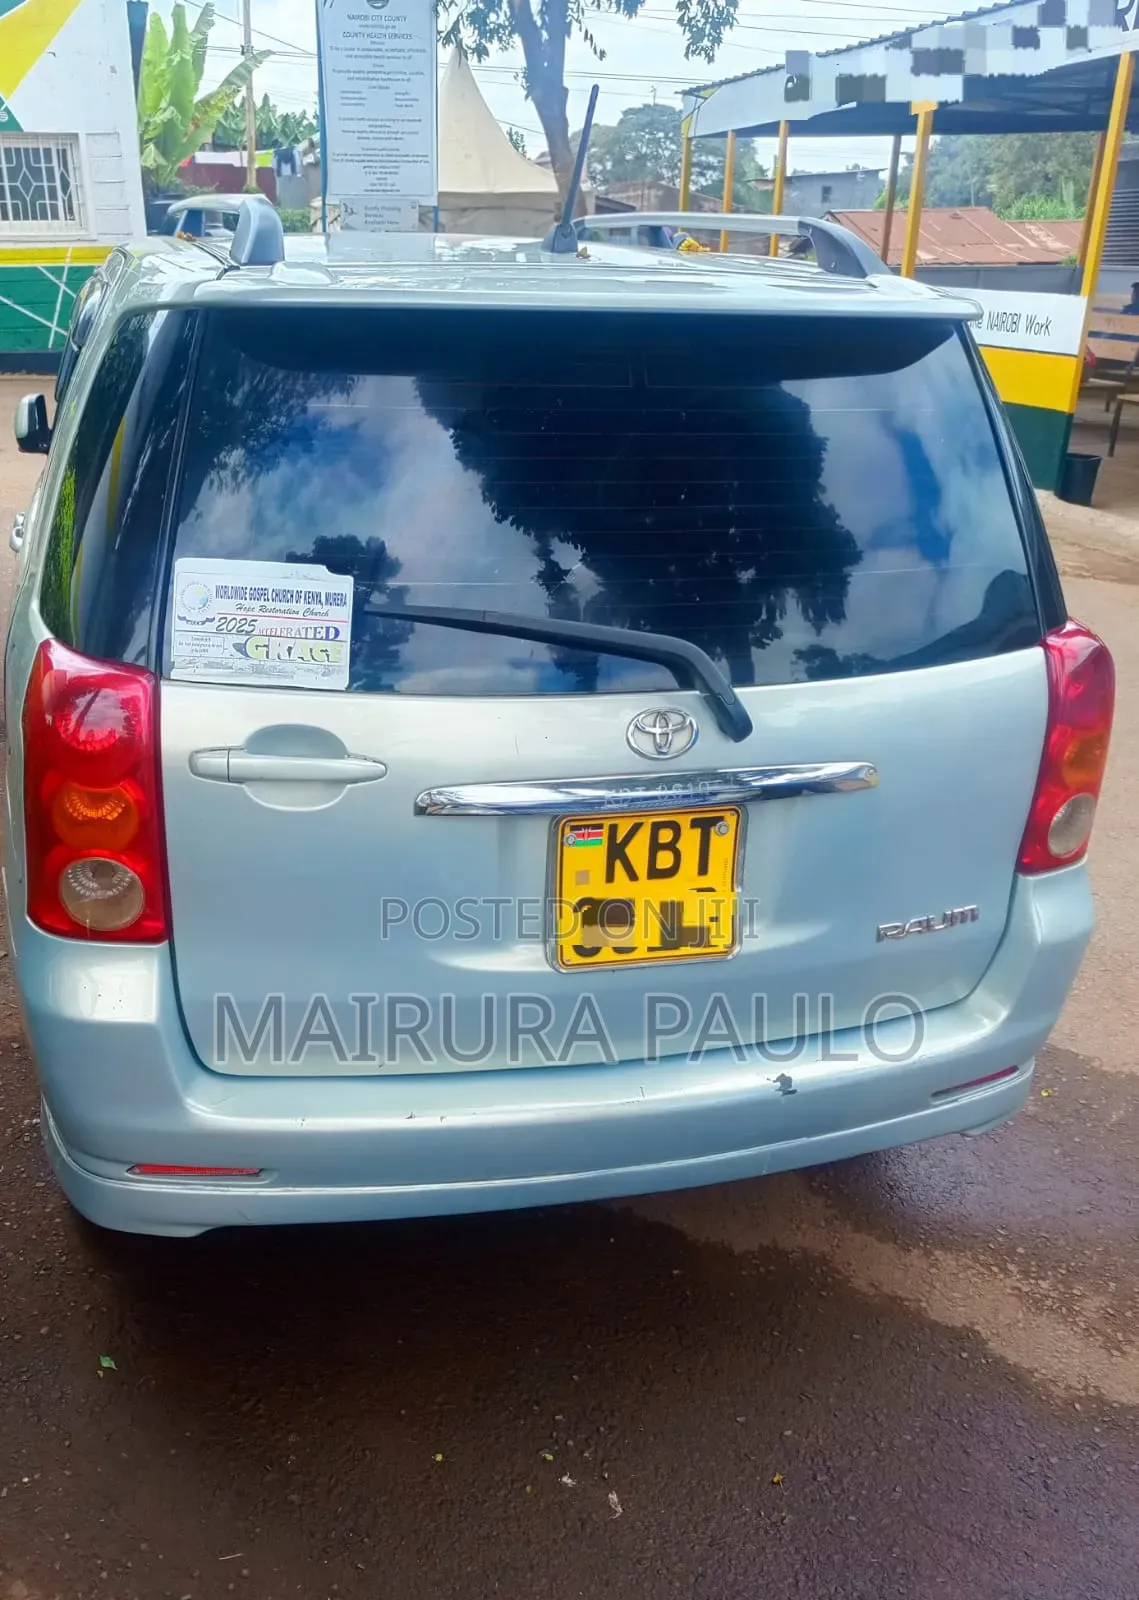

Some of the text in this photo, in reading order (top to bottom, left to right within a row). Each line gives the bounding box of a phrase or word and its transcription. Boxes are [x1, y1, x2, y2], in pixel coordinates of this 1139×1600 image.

[986, 309, 1022, 334] NAIROBI
[215, 584, 248, 601] WORLDWIDE
[248, 586, 270, 603] GOSPEL
[271, 588, 295, 604] CHURCH
[295, 590, 303, 604] OF
[303, 590, 325, 609] KENYA,
[325, 591, 348, 608] MURERA
[235, 603, 330, 618] Hope Restoration Church
[215, 616, 258, 634] 2025
[605, 815, 725, 885] KBT
[876, 904, 979, 943] RAUM
